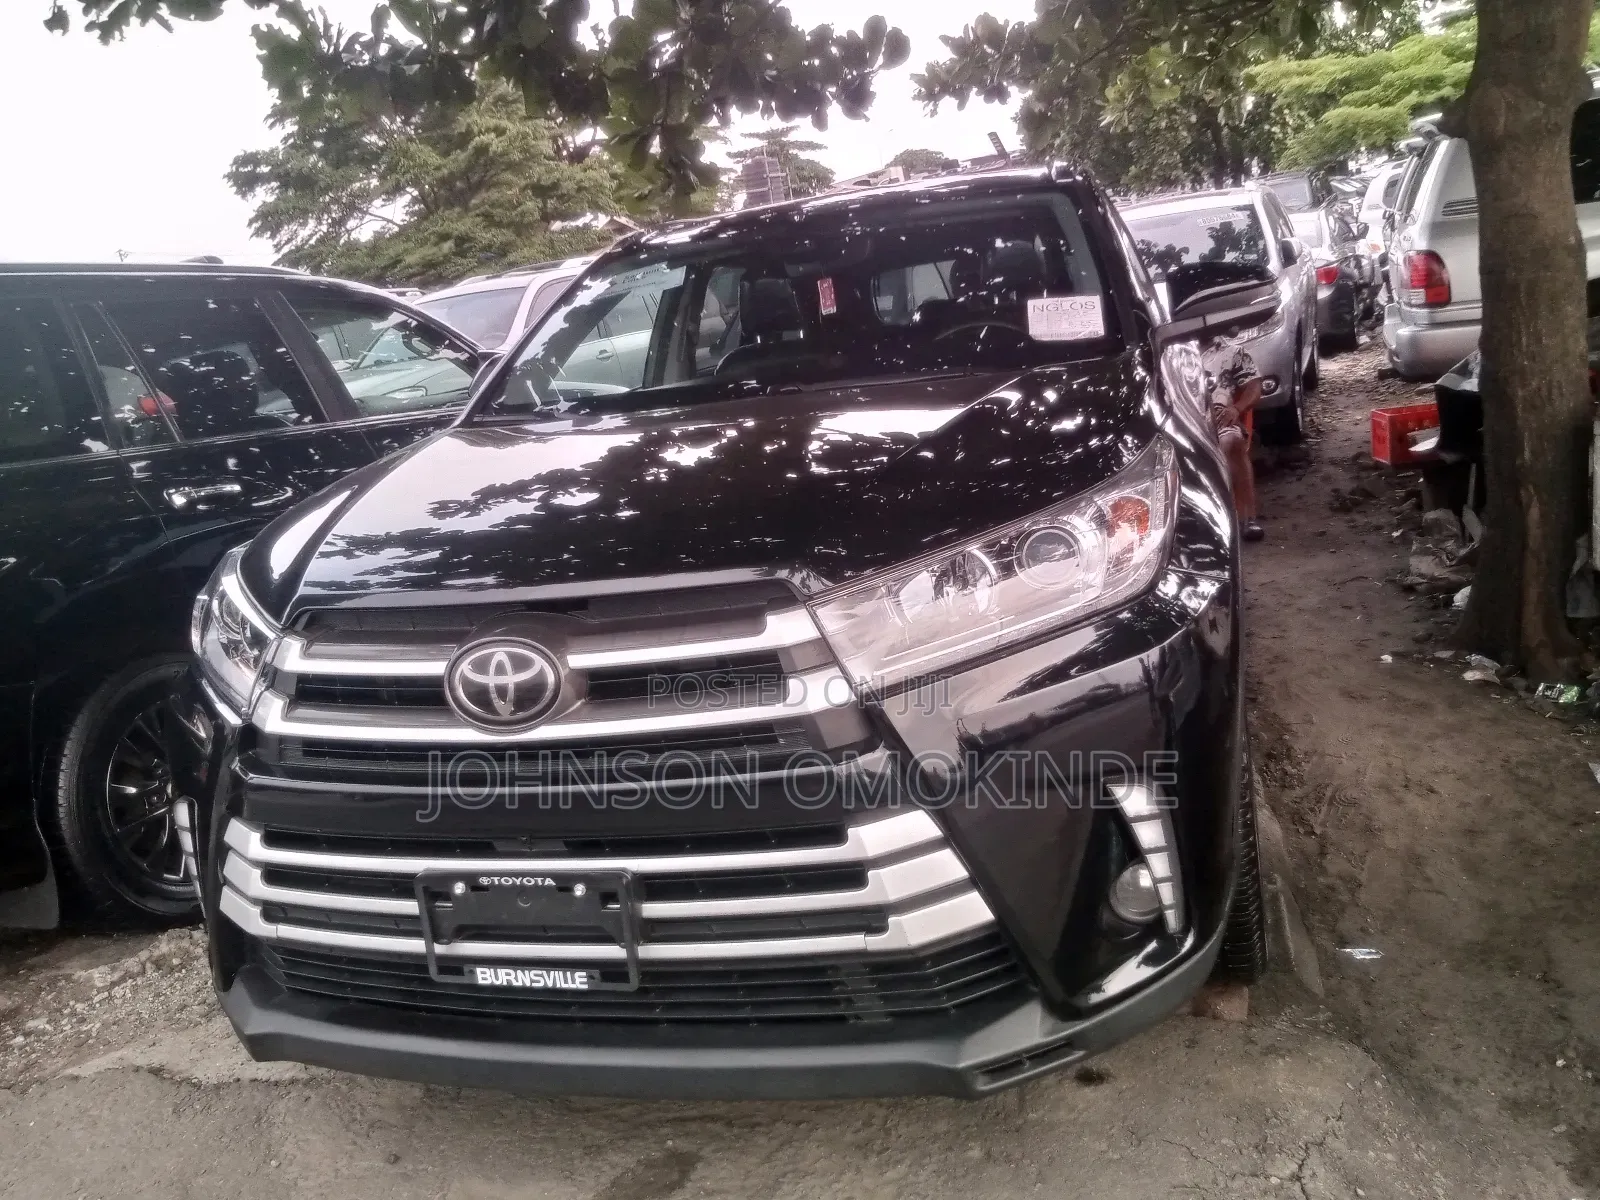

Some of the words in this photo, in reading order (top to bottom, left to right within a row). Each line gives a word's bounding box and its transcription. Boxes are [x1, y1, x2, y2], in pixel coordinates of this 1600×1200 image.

[1032, 301, 1096, 313] NGLOS
[490, 876, 557, 886] TOYOTA
[475, 967, 589, 989] BURNSVILLE
